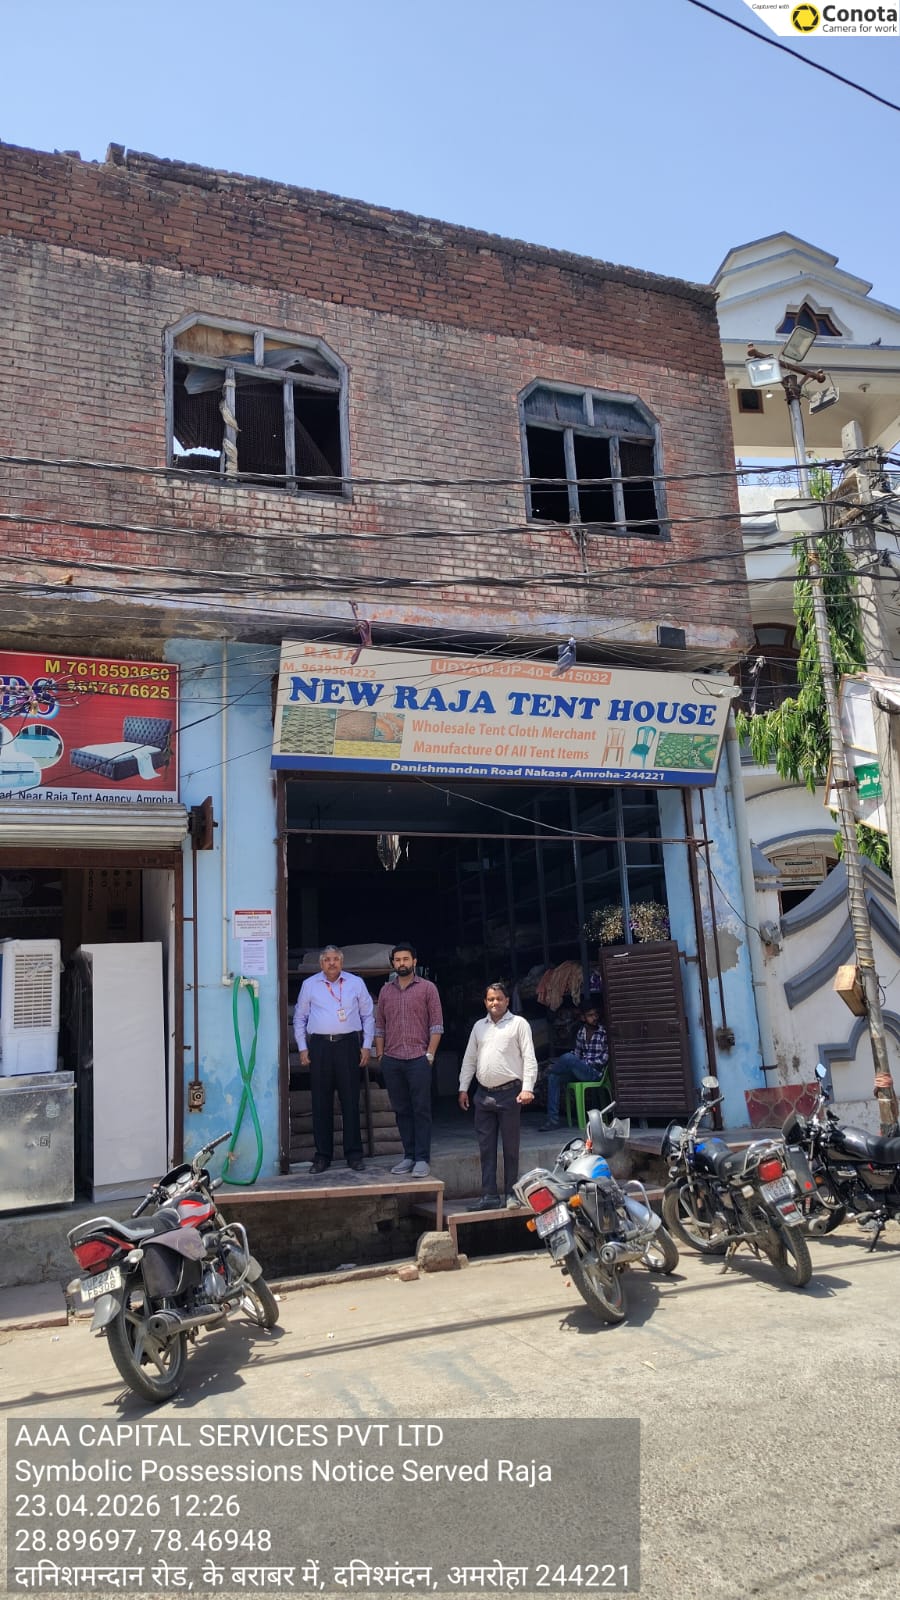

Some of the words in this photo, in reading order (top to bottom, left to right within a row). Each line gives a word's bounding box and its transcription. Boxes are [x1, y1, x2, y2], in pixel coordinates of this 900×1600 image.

[289, 676, 385, 706] NEW
[393, 685, 497, 713] RAJA
[508, 692, 600, 720] TENT
[607, 699, 717, 726] HOUSE
[412, 719, 476, 735] Wholesale
[479, 722, 505, 737] Tent
[508, 723, 540, 738] Cloth
[542, 725, 597, 741] Merchant
[413, 740, 493, 756] Manufacture
[495, 744, 510, 757] Of
[511, 744, 526, 758] All
[528, 746, 555, 759] Tent
[557, 746, 590, 760] Items
[391, 762, 488, 775] Danishmandan
[490, 766, 522, 776] Road
[524, 768, 568, 778] Nakasa
[71, 792, 92, 802] Tent
